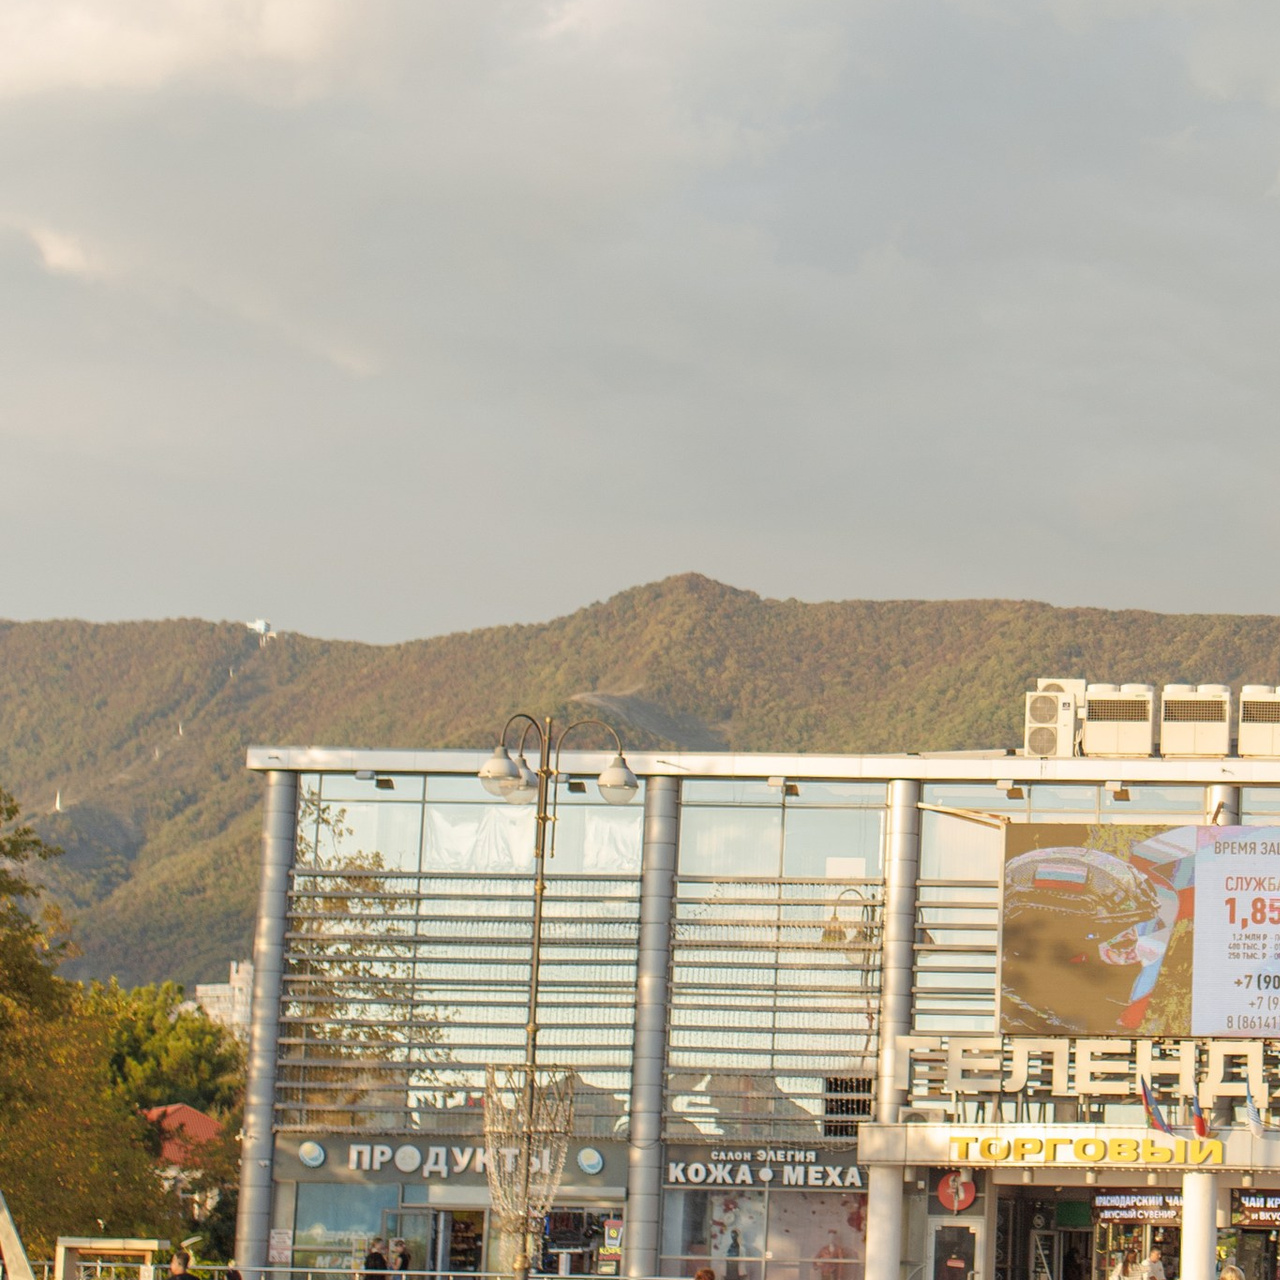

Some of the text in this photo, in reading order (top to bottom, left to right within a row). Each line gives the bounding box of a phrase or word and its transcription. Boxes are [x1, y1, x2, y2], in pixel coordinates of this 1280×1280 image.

[1214, 841, 1256, 855] ВРЕМЯ
[1234, 974, 1253, 989] +7
[1249, 997, 1263, 1009] +7
[1226, 1016, 1234, 1029] 8
[949, 1132, 1223, 1164] ТОРГОВЫЙ
[711, 1149, 816, 1163] САЛОН ЭЛЕГИЯ
[668, 1162, 862, 1187] КОЖА МЕХА
[1104, 1209, 1136, 1219] ВКУСНЫЙ
[1137, 1210, 1177, 1219] СУВЕНИР
